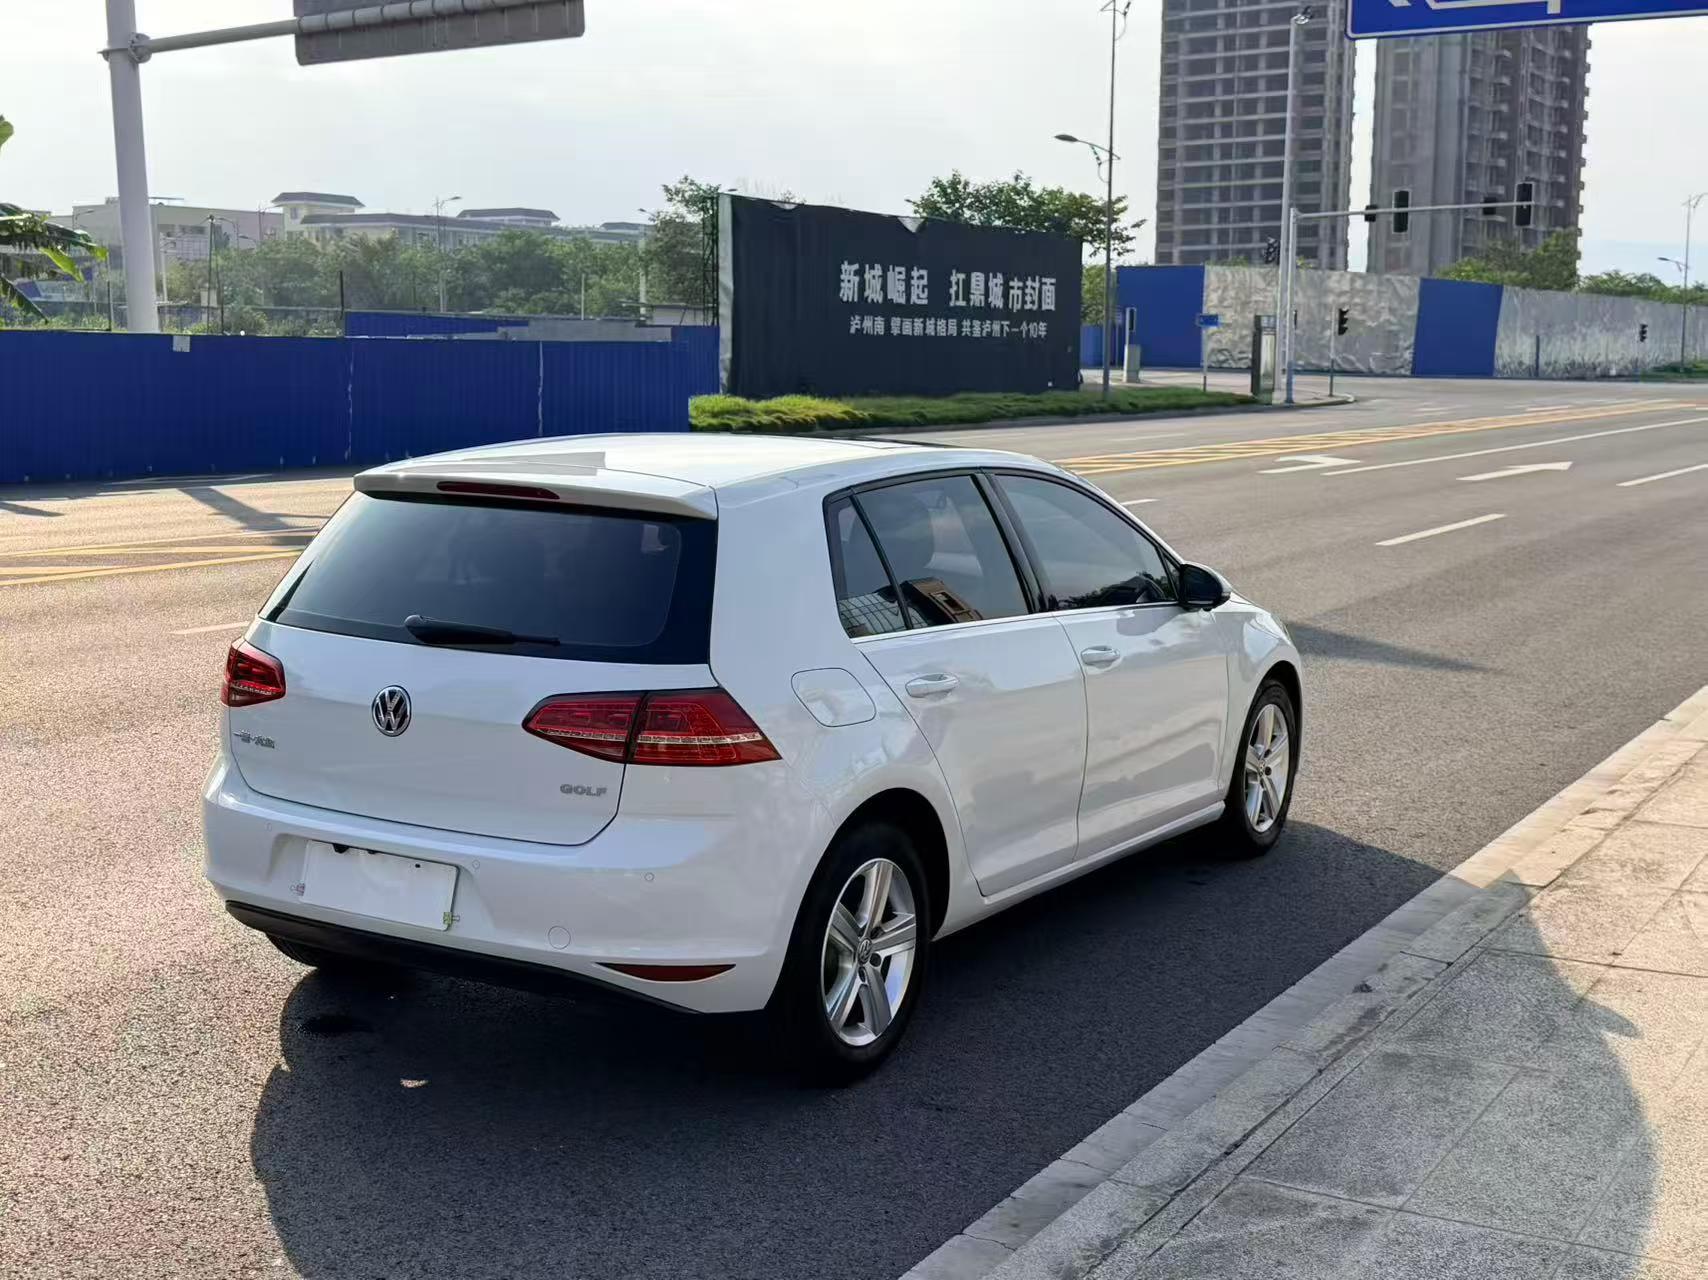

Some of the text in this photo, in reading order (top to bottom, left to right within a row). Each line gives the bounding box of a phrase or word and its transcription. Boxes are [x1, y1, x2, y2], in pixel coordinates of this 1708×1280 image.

[839, 260, 928, 305] 新城崛起
[849, 314, 885, 336] 泸州南
[560, 783, 608, 797] GOLF
